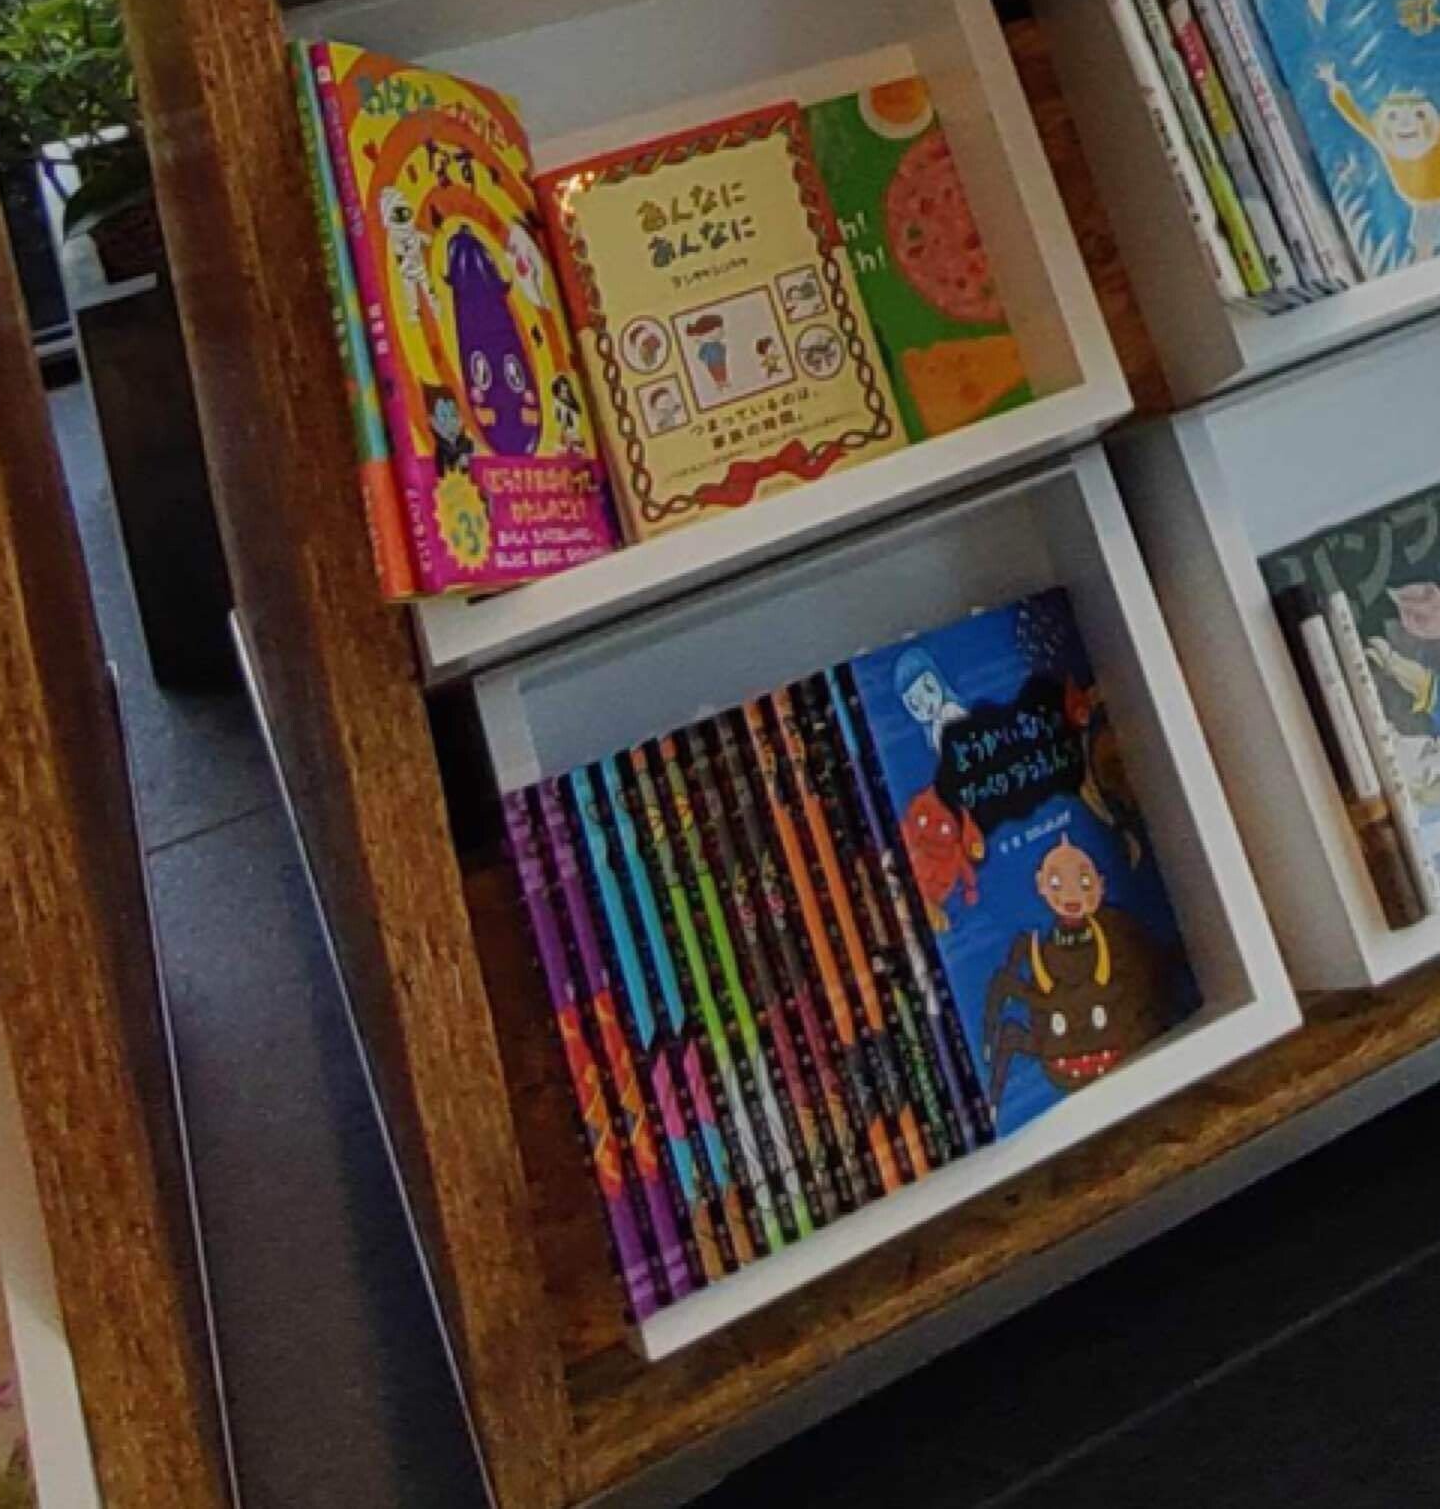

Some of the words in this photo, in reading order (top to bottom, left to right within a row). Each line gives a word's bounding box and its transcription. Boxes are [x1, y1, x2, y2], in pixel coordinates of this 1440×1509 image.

[636, 181, 747, 234] あんなに
[647, 215, 756, 269] あんなに
